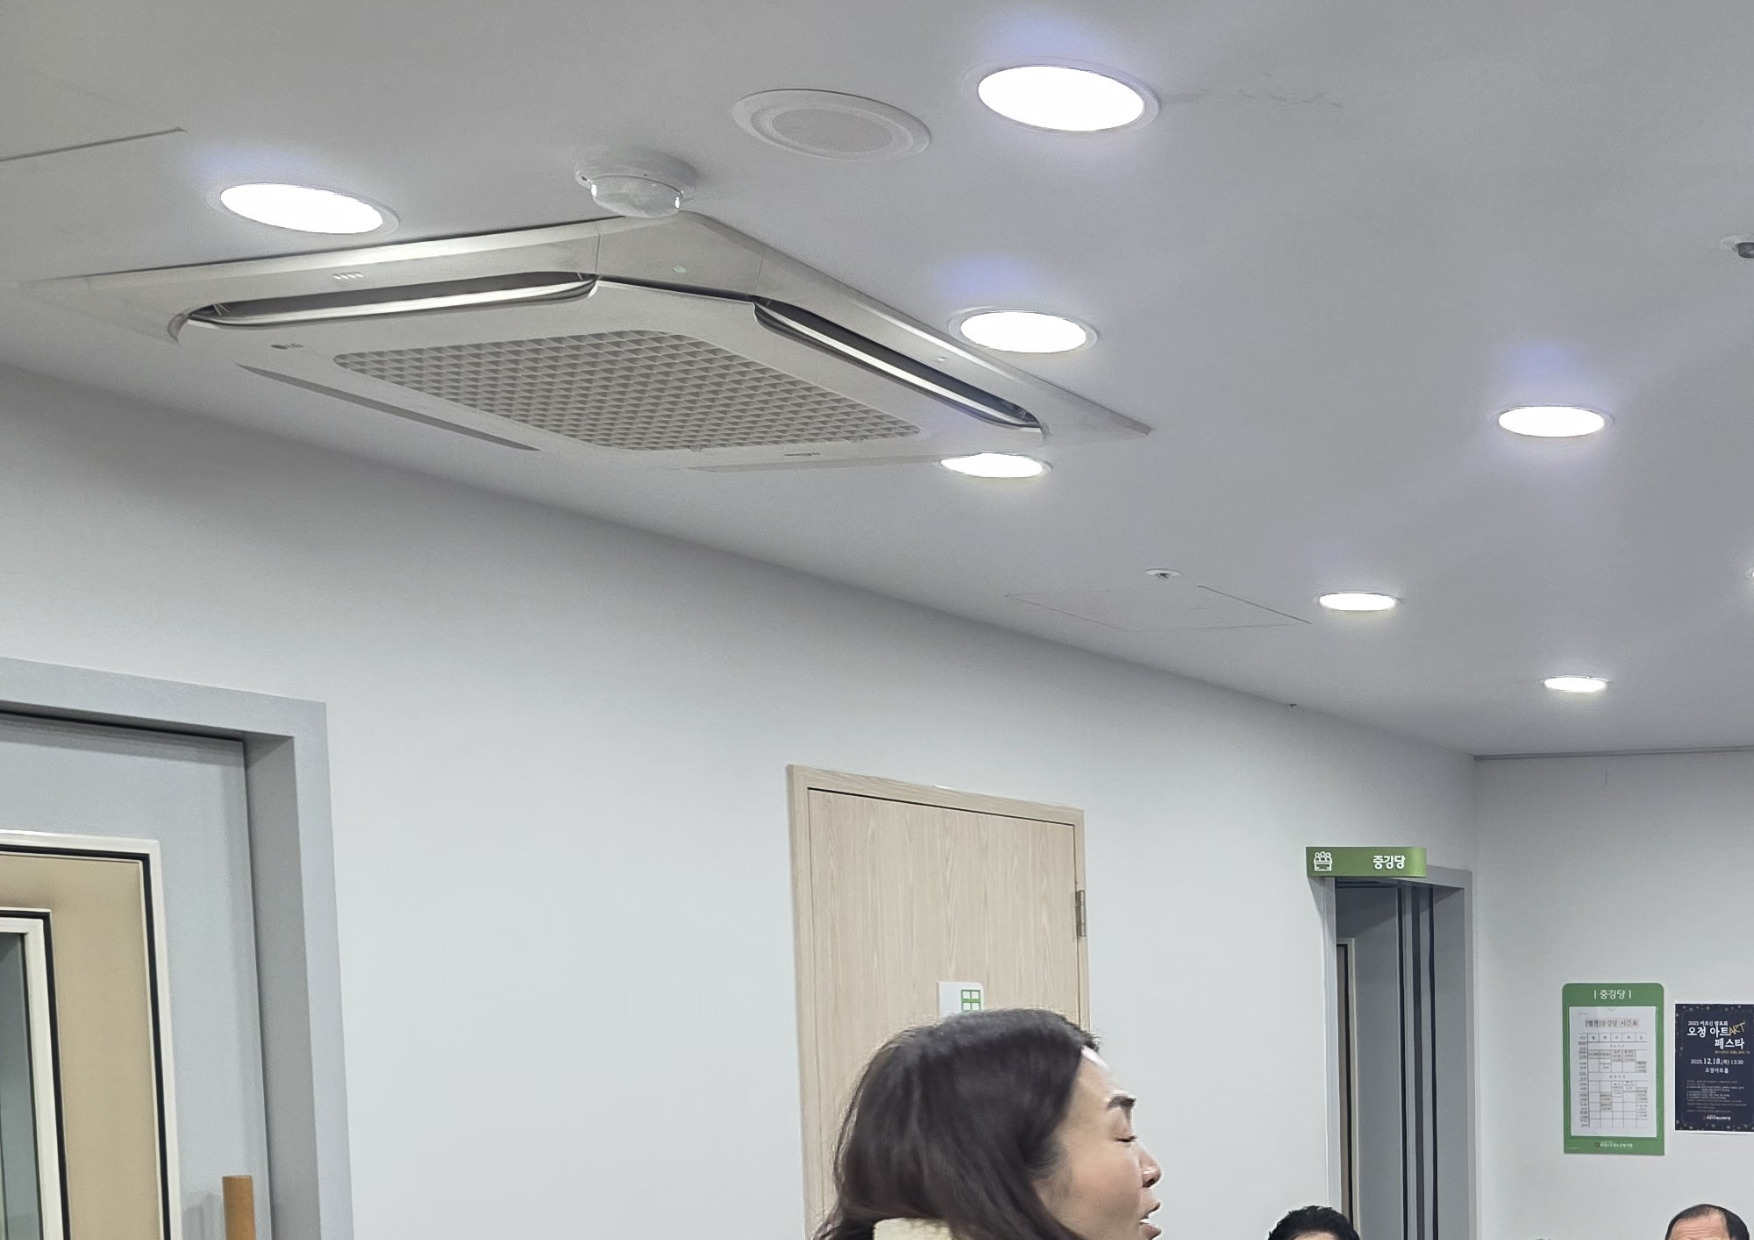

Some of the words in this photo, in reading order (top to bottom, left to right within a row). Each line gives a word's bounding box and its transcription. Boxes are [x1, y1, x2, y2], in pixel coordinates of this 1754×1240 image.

[1373, 855, 1406, 870] 중강당
[1600, 989, 1626, 1000] 중강당
[1687, 1027, 1707, 1038] 오정
[1709, 1027, 1731, 1038] 아트
[1714, 1038, 1745, 1050] 페스타
